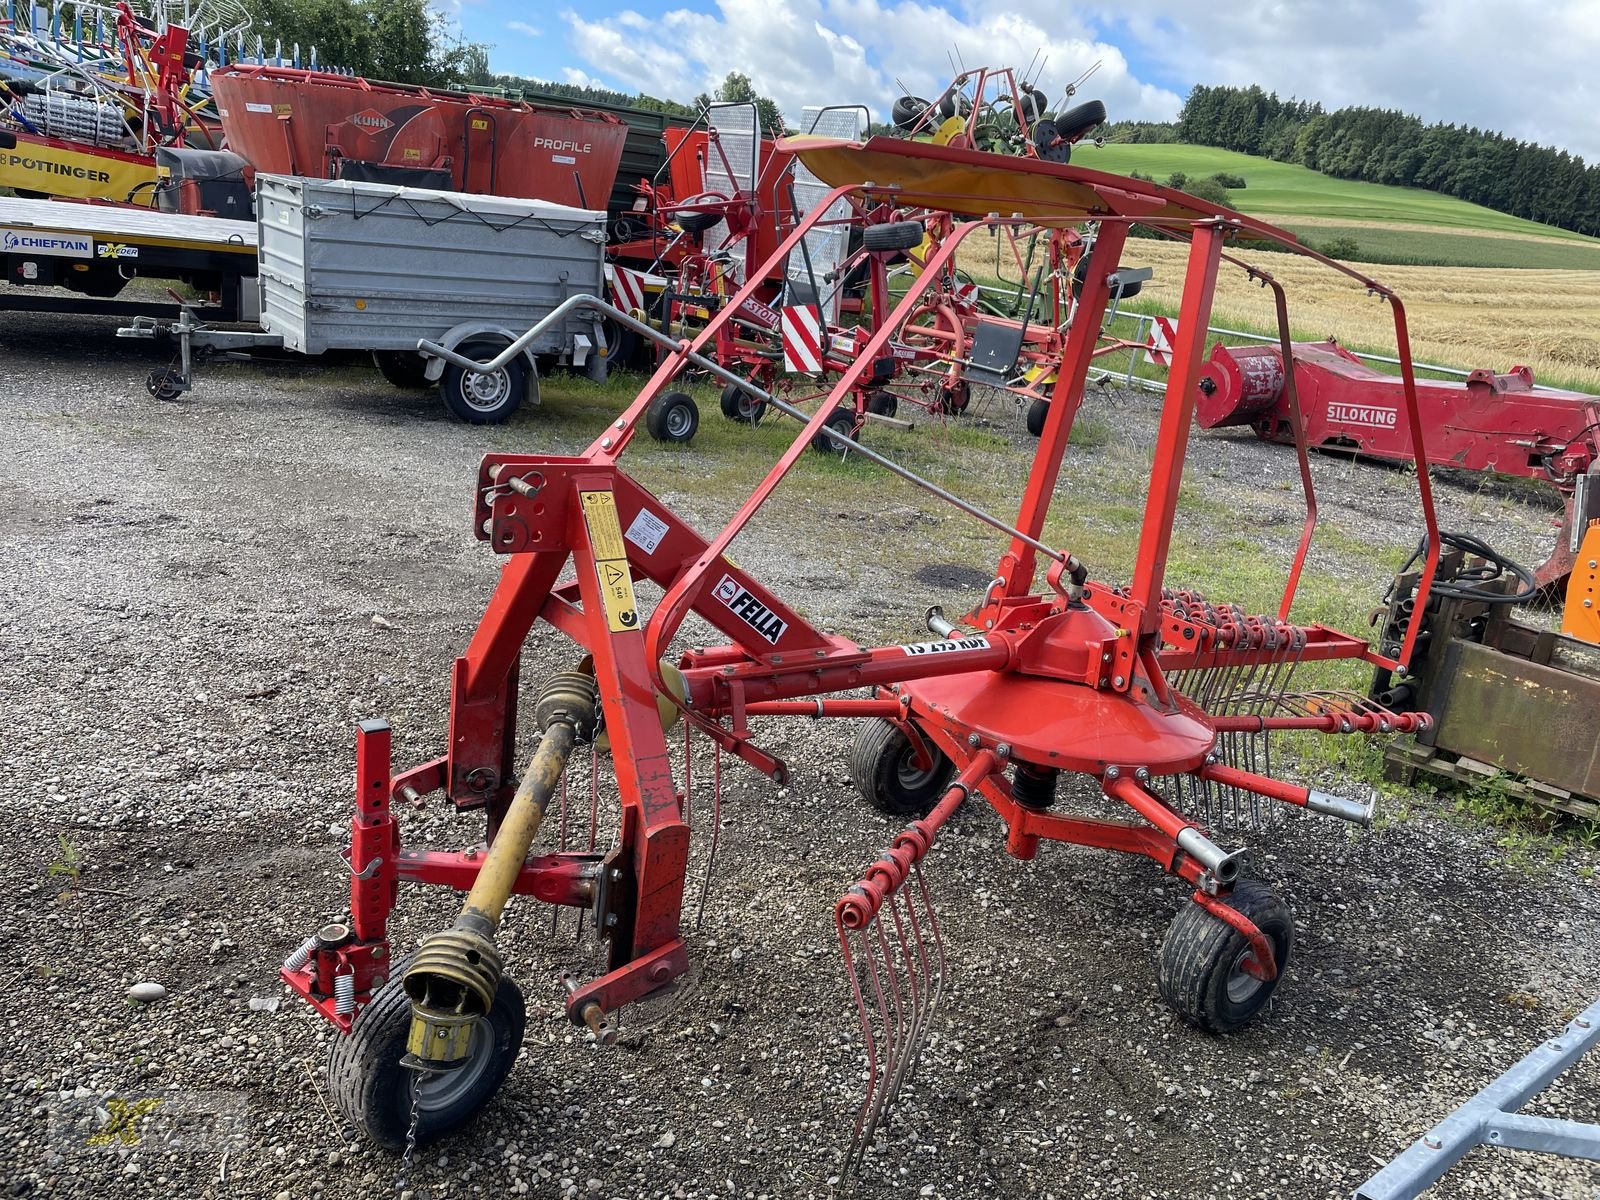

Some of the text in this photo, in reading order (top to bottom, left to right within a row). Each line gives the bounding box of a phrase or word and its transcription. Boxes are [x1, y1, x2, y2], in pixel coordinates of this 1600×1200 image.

[353, 114, 388, 128] KUHN
[534, 137, 592, 153] PROFILE
[21, 237, 88, 251] CHIEFTAIN
[1327, 406, 1397, 425] SILOKING
[615, 586, 624, 599] 540
[729, 591, 783, 643] FELLA
